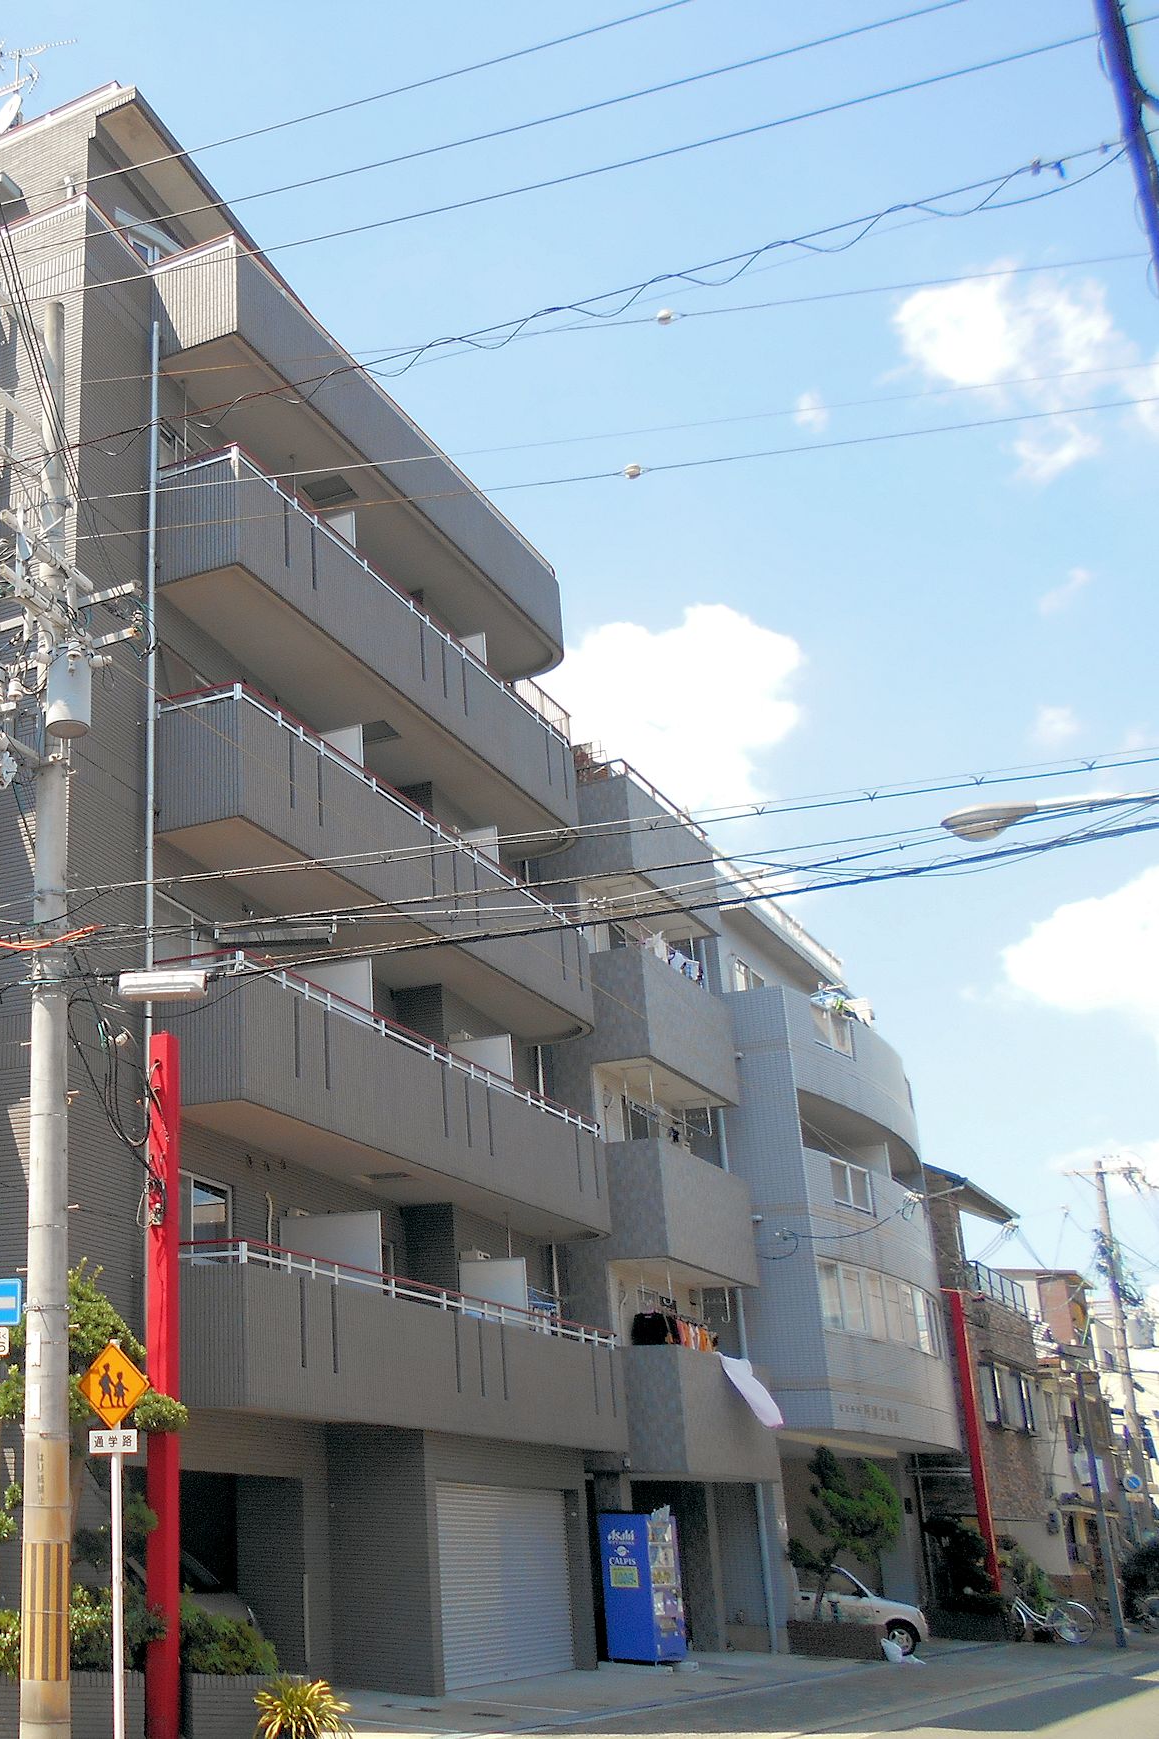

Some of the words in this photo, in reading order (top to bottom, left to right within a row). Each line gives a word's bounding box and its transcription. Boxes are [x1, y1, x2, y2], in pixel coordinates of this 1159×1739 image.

[94, 1435, 132, 1448] 通学路
[607, 1529, 635, 1541] Asahi
[608, 1556, 637, 1566] CALPIS
